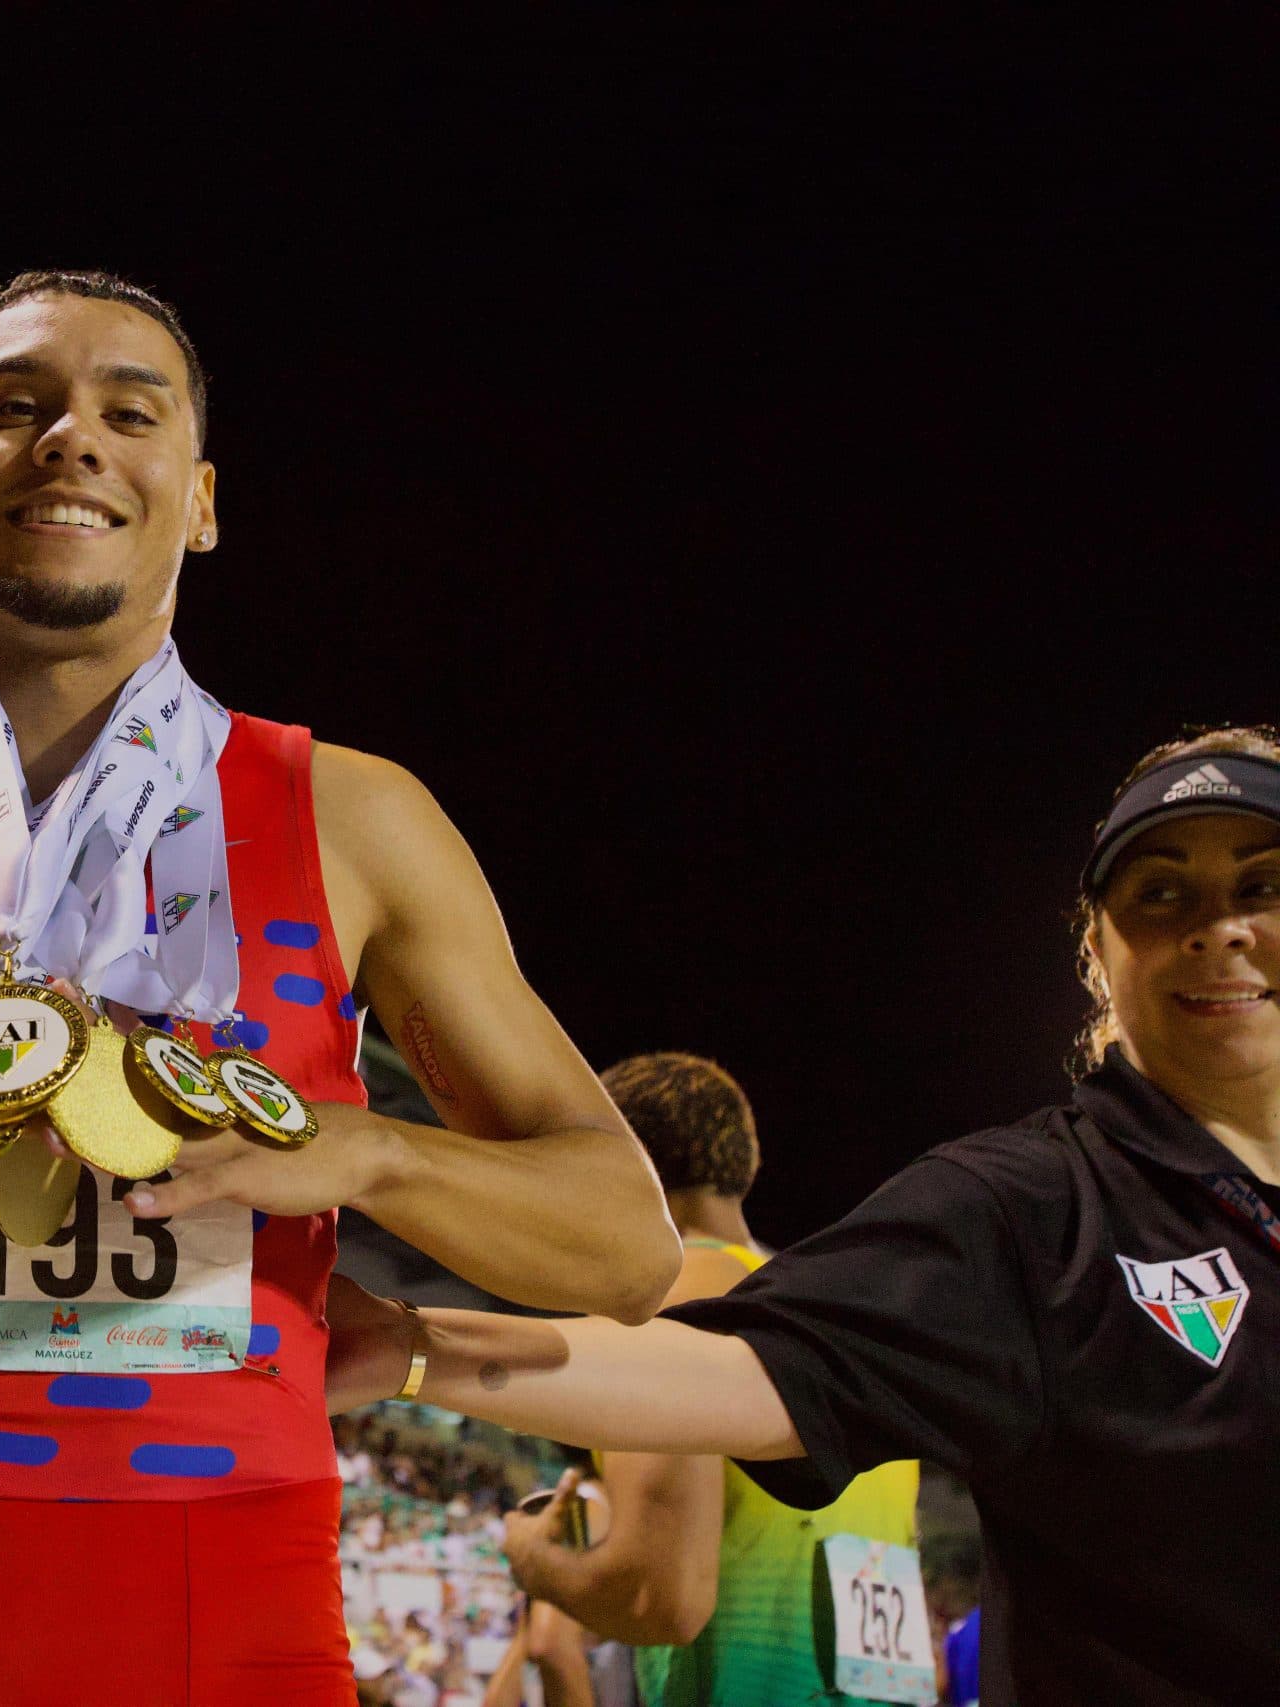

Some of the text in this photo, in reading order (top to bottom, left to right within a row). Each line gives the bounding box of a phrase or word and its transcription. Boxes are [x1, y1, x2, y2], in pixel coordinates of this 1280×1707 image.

[159, 704, 173, 723] 95
[114, 716, 148, 743] LAI
[1163, 781, 1241, 803] adidas
[163, 896, 180, 932] LAI
[1127, 1253, 1240, 1300] LAI
[851, 1577, 913, 1662] 252
